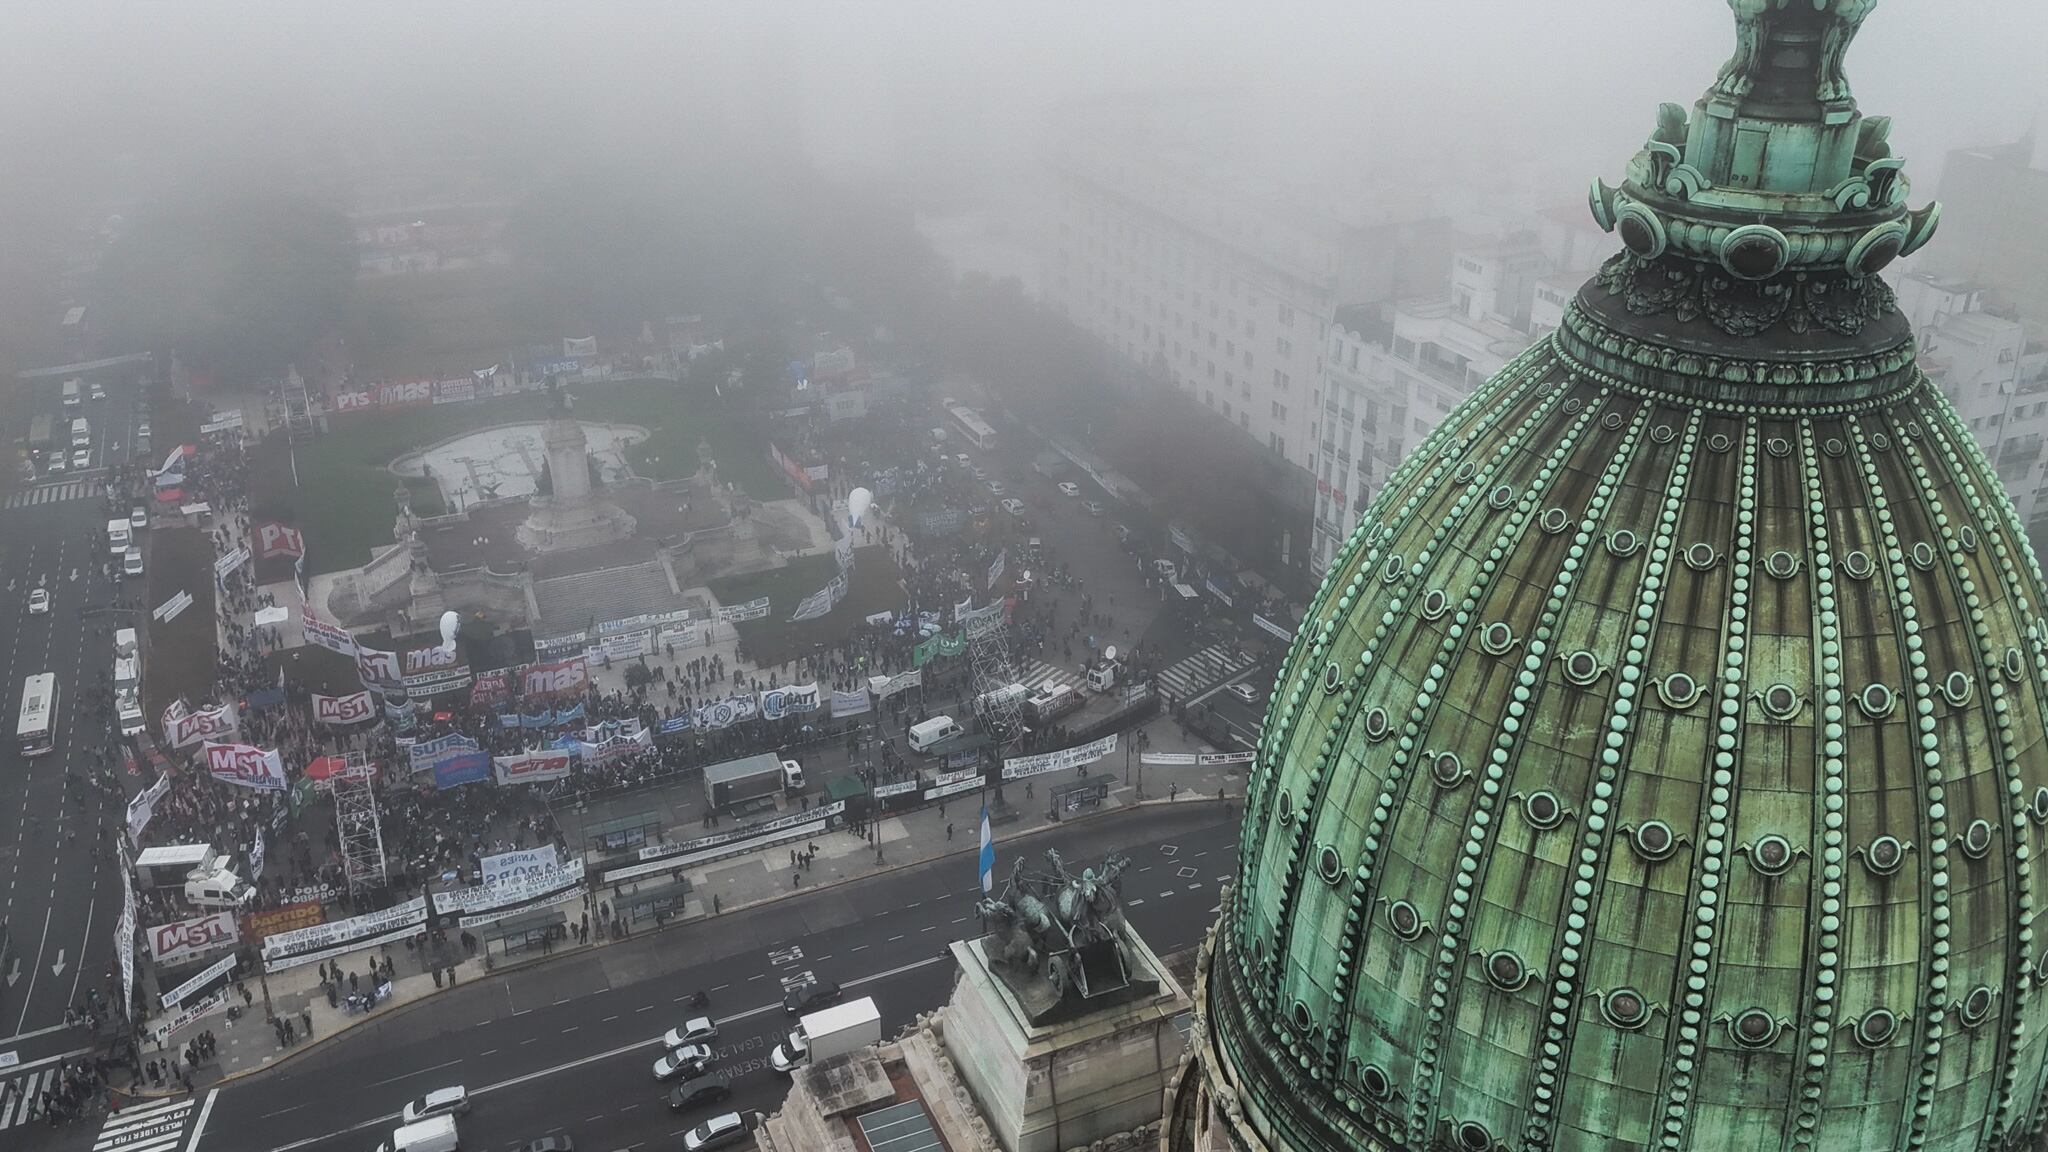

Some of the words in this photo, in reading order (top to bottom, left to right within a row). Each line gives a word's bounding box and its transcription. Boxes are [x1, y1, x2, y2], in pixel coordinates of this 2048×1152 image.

[322, 698, 365, 719] MST
[181, 713, 224, 740] MST
[211, 750, 266, 779] MST
[295, 883, 329, 895] POLO
[251, 904, 321, 929] PARTIDO
[162, 922, 223, 951] MST
